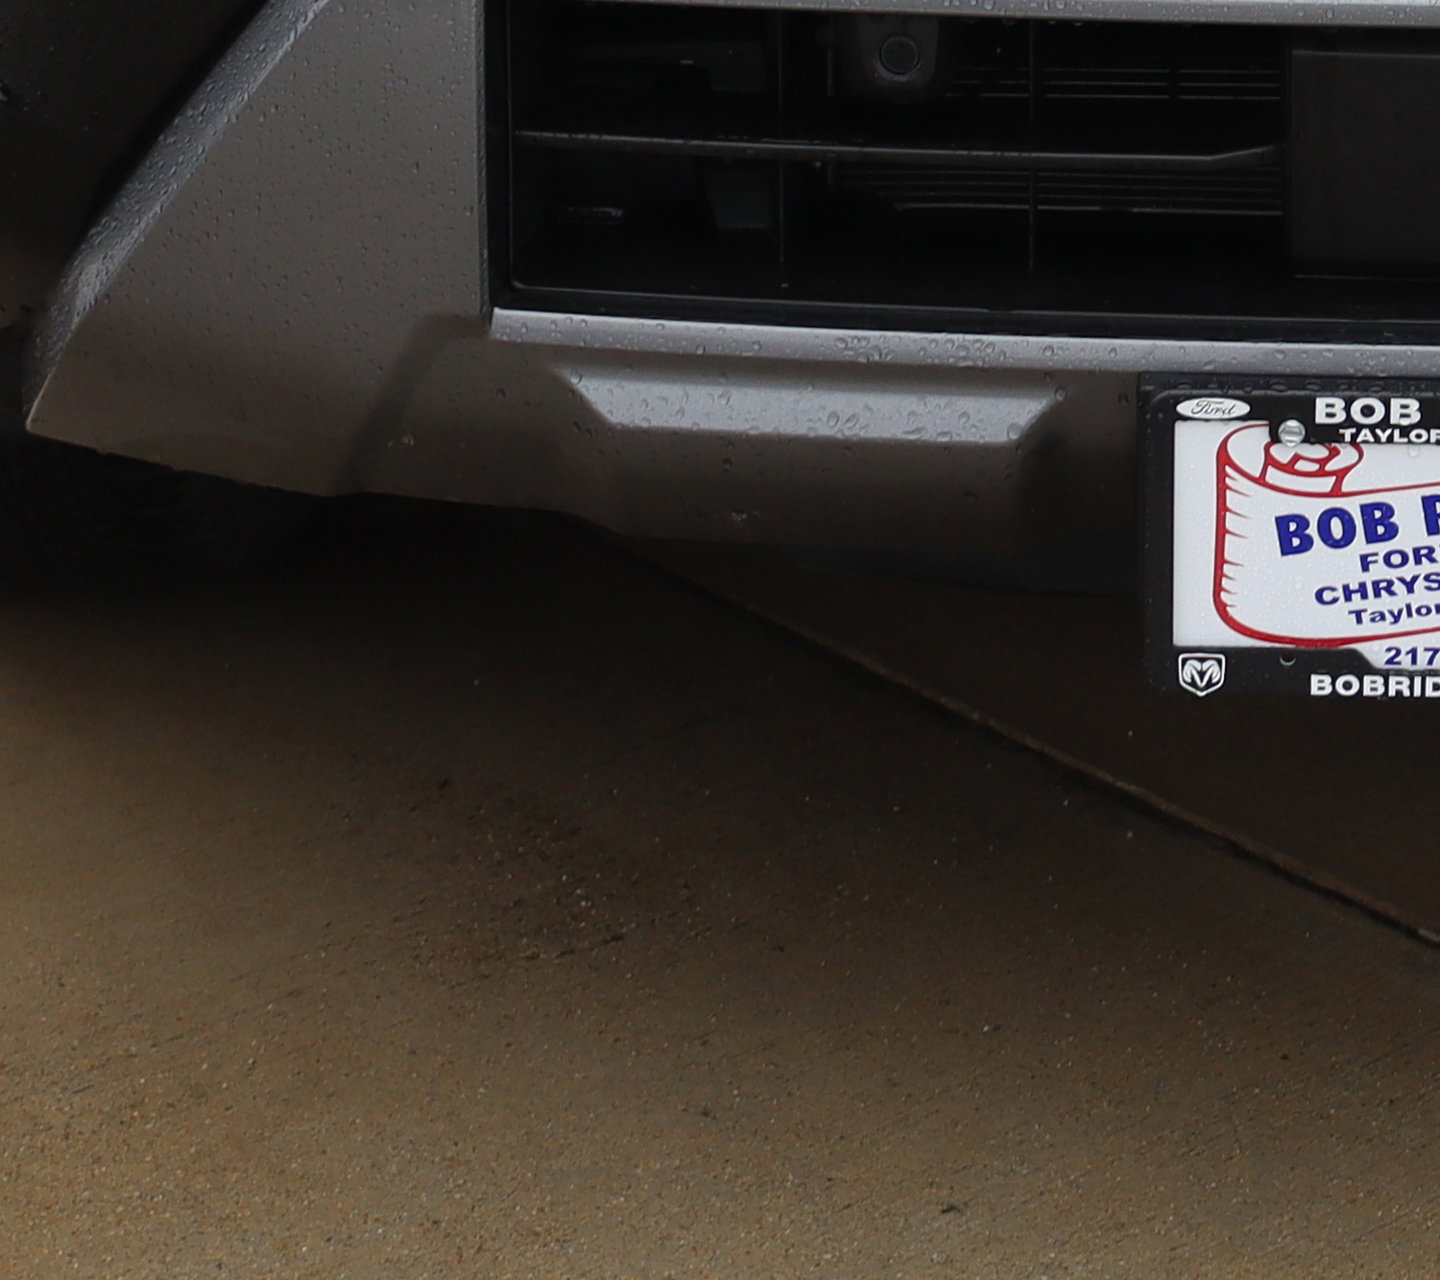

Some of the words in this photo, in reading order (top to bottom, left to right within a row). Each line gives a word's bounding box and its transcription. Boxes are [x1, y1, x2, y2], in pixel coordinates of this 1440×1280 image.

[1191, 399, 1238, 416] Ford
[1315, 396, 1422, 426] BOB
[1274, 501, 1400, 557] BOB
